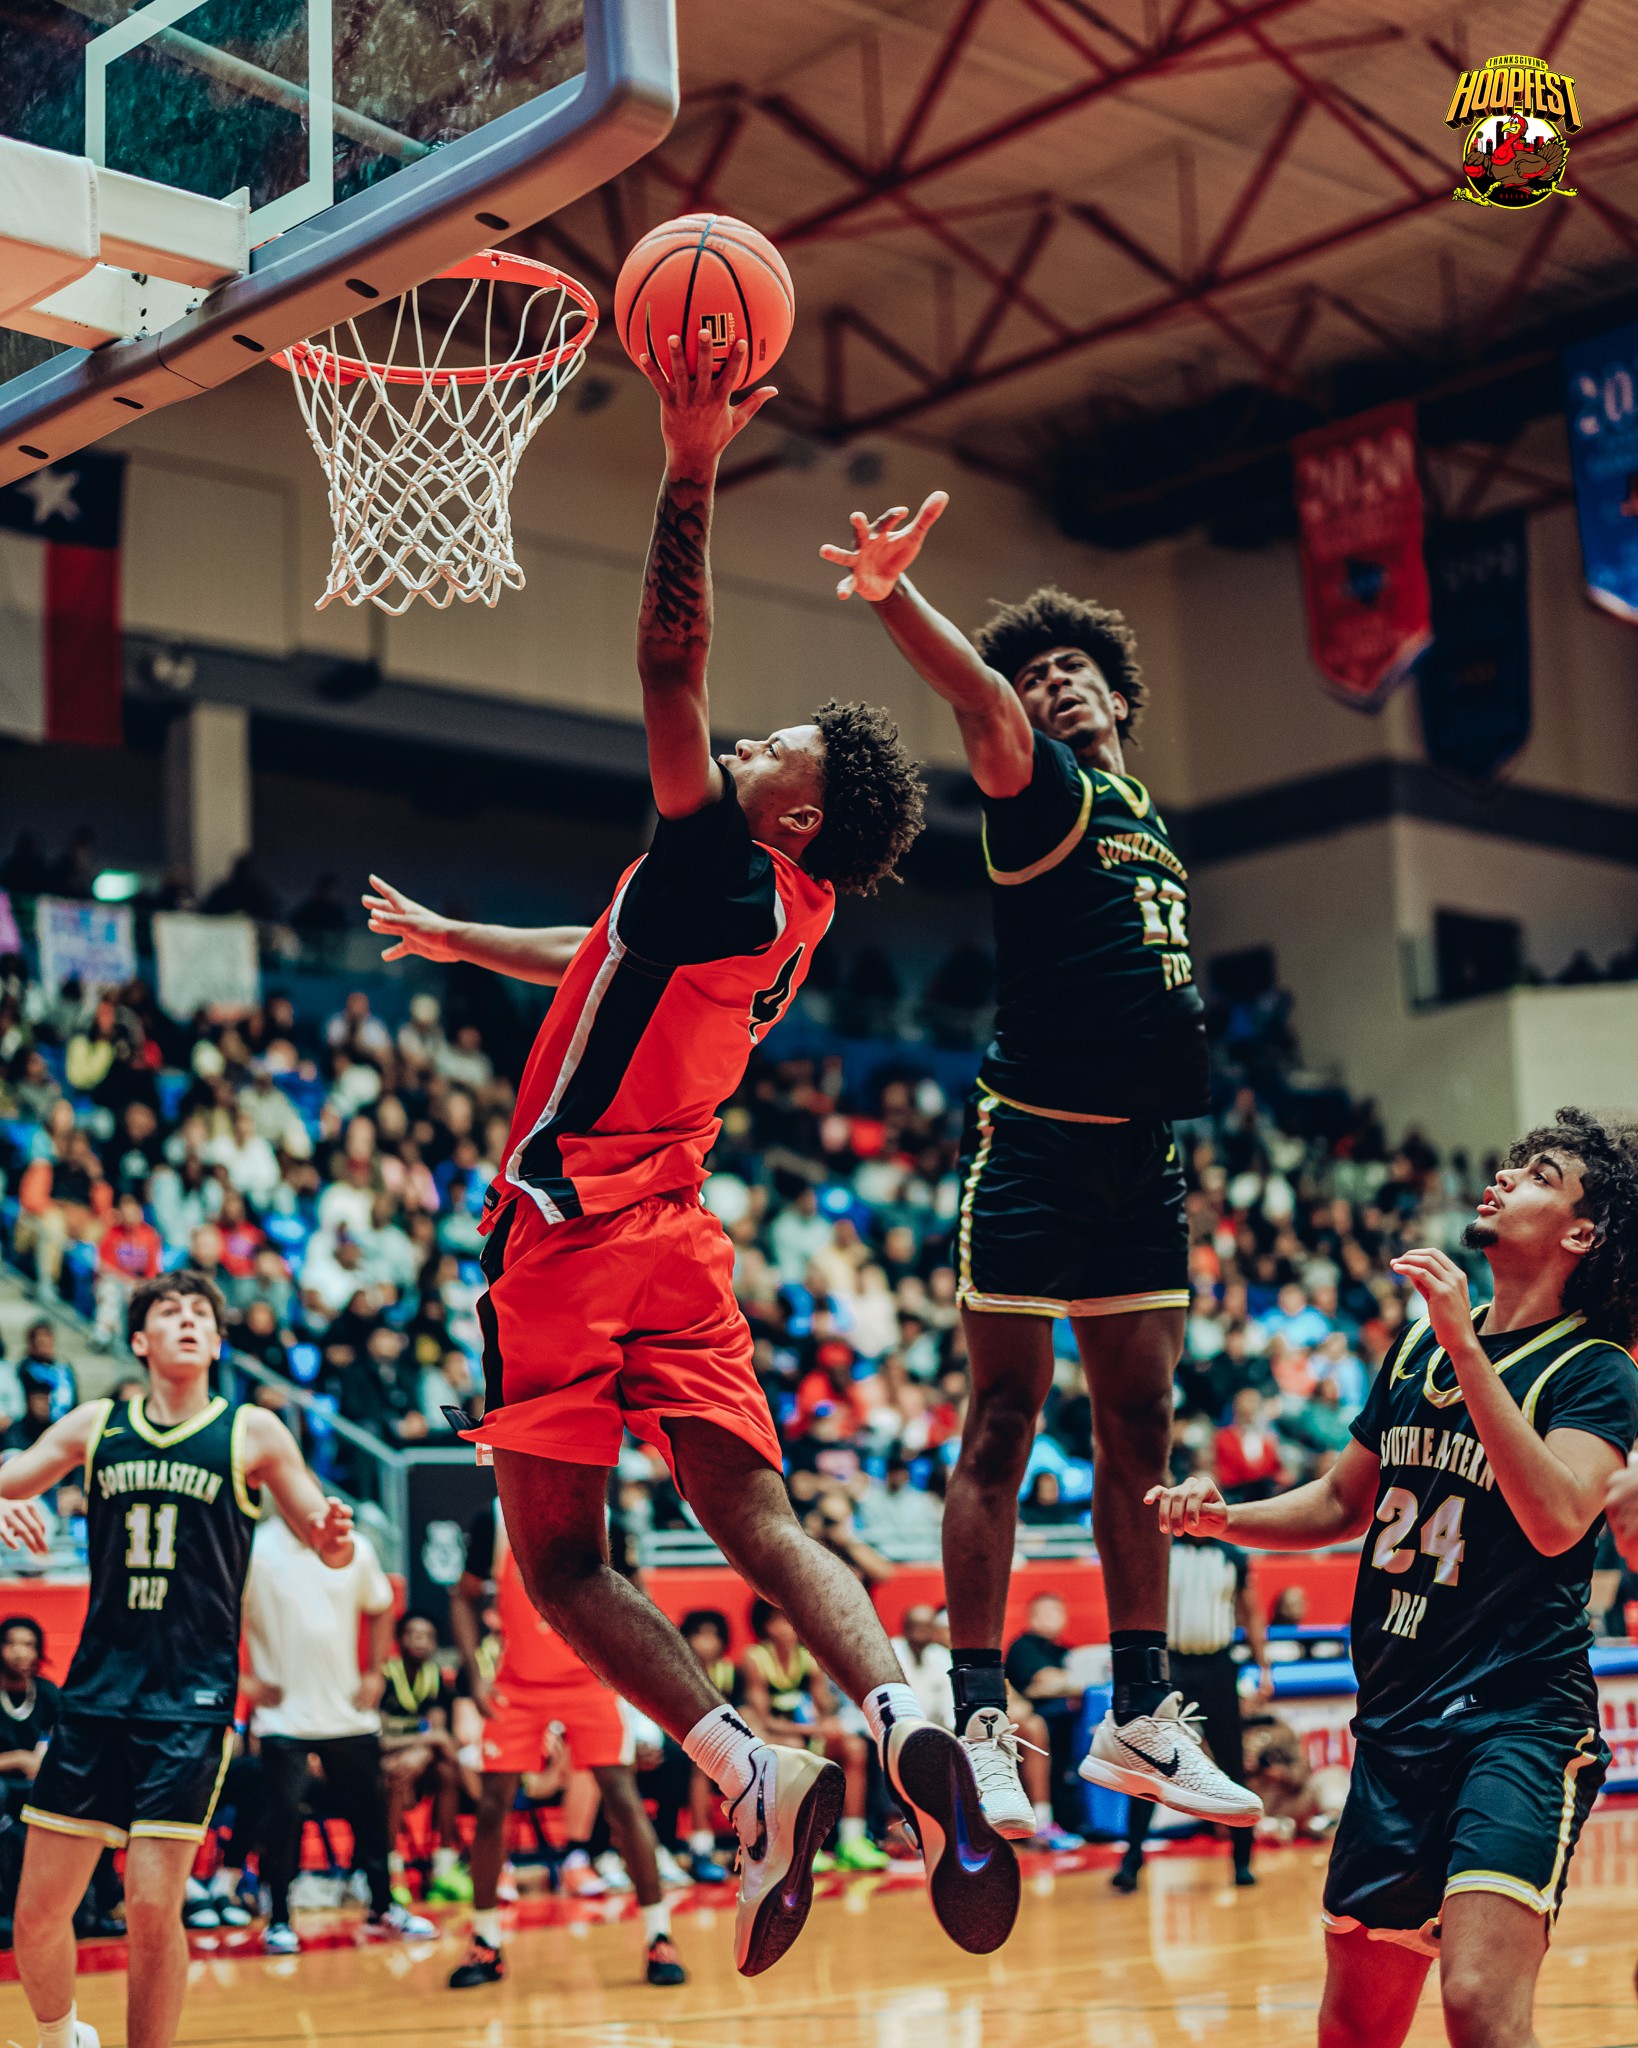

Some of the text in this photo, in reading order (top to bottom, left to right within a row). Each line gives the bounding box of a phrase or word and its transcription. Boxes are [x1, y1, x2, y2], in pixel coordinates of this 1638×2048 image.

[1133, 876, 1189, 947] 12
[97, 1459, 224, 1505] SOUTHEASTERN
[1379, 1426, 1497, 1492] SOUTHEATERN
[125, 1503, 178, 1570] 11
[1371, 1487, 1466, 1586] 24
[1381, 1588, 1427, 1640] PREP
